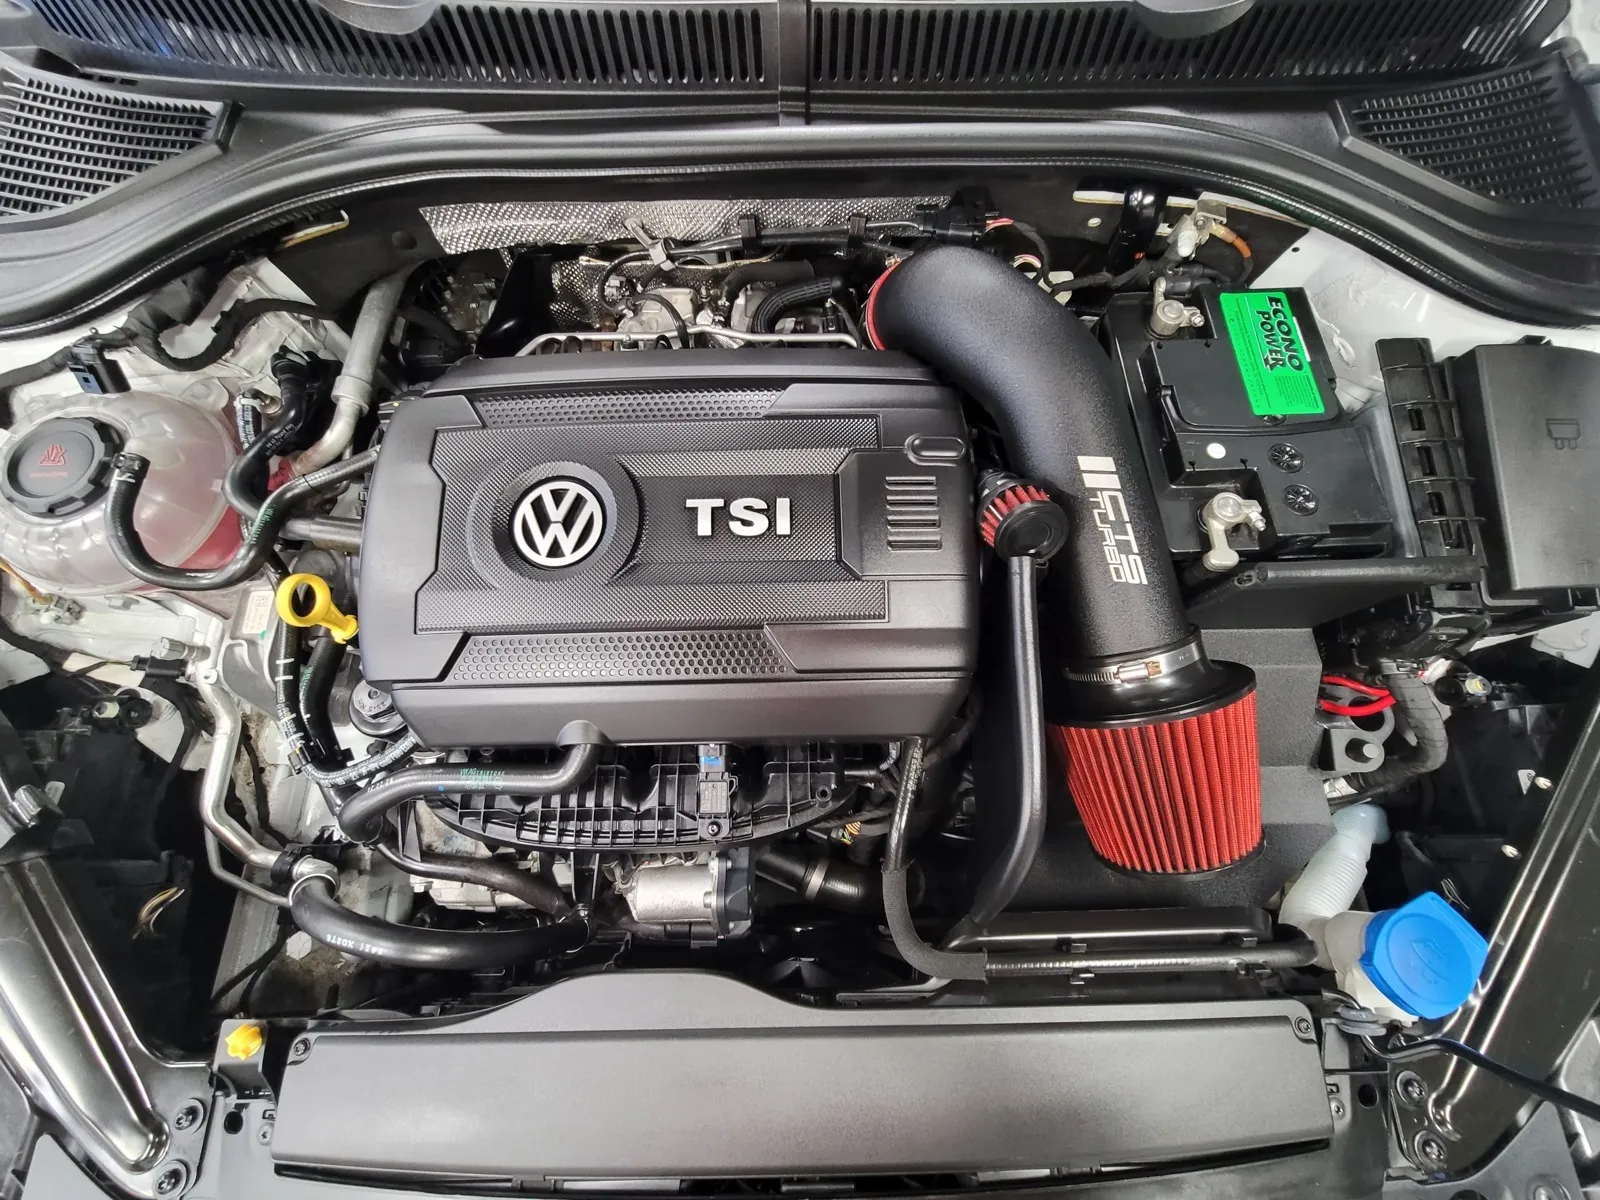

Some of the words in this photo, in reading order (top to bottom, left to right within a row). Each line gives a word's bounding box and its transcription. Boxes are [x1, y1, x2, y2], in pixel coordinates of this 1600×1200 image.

[1255, 309, 1287, 372] POWER
[1266, 295, 1305, 372] ECONO
[513, 480, 603, 567] VW
[685, 497, 791, 537] TSI
[1089, 490, 1127, 583] TURBO
[1101, 490, 1148, 585] CTS
